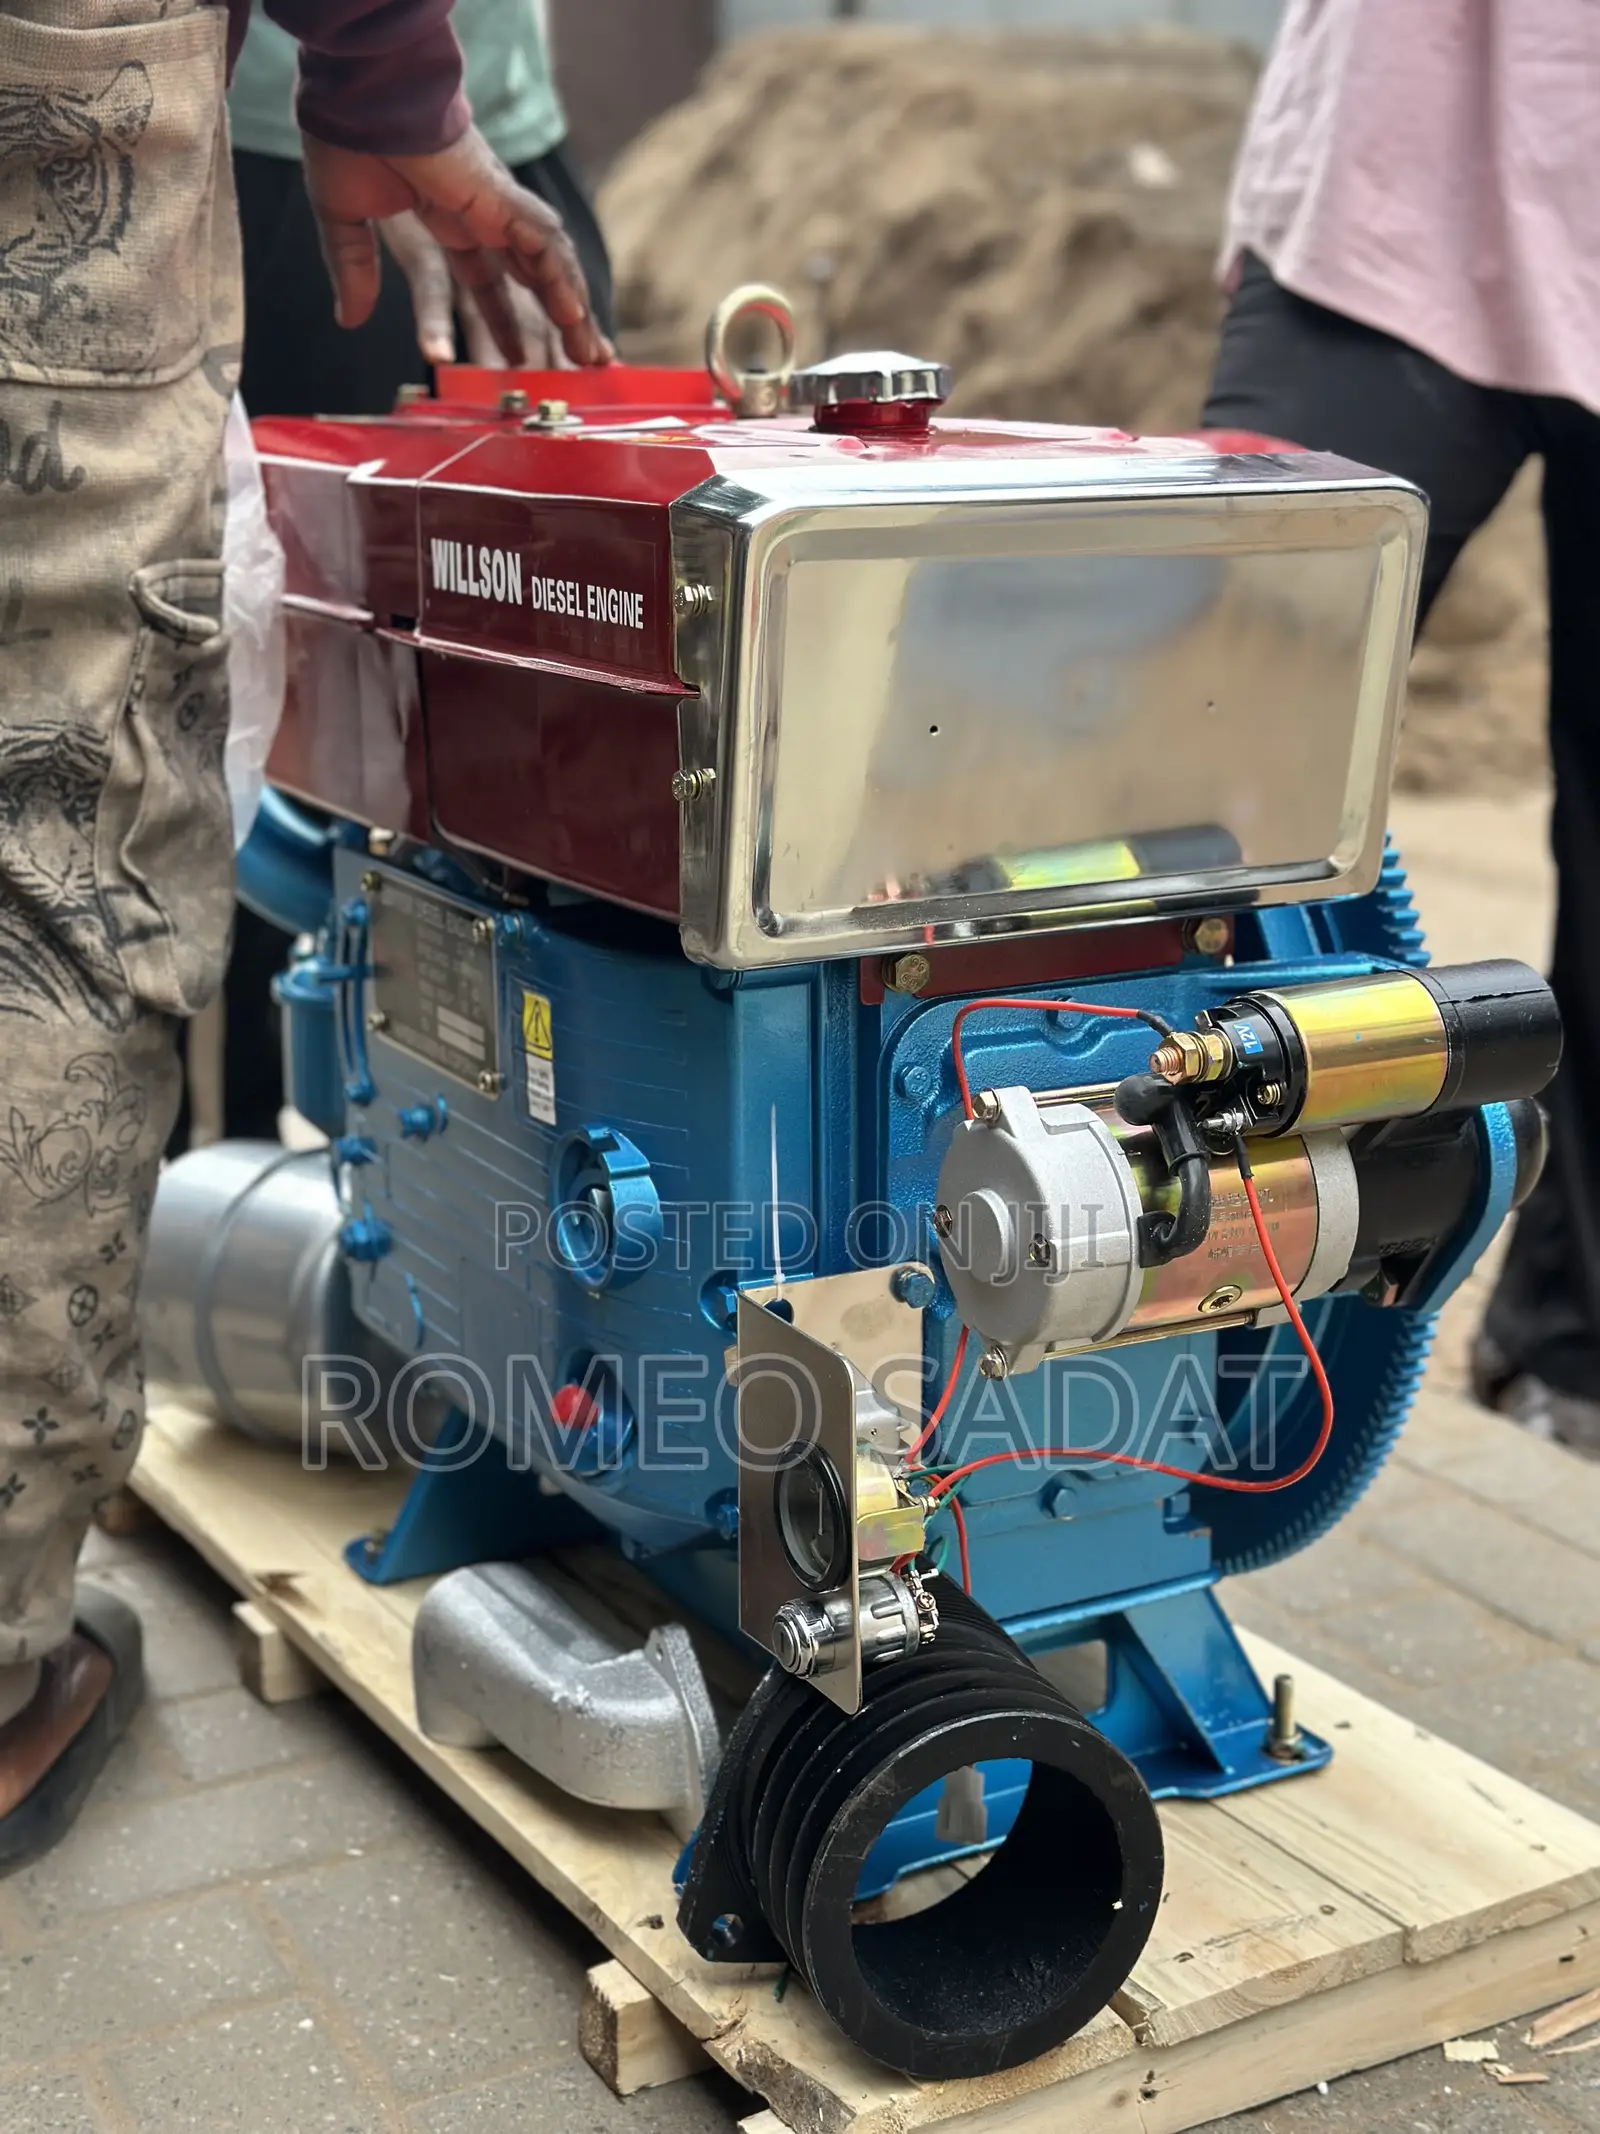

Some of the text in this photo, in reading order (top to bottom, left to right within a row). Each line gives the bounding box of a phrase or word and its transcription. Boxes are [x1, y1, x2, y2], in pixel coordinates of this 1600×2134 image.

[431, 538, 644, 629] WILLSON DIESEL ENGINE
[1233, 1024, 1258, 1049] 12V
